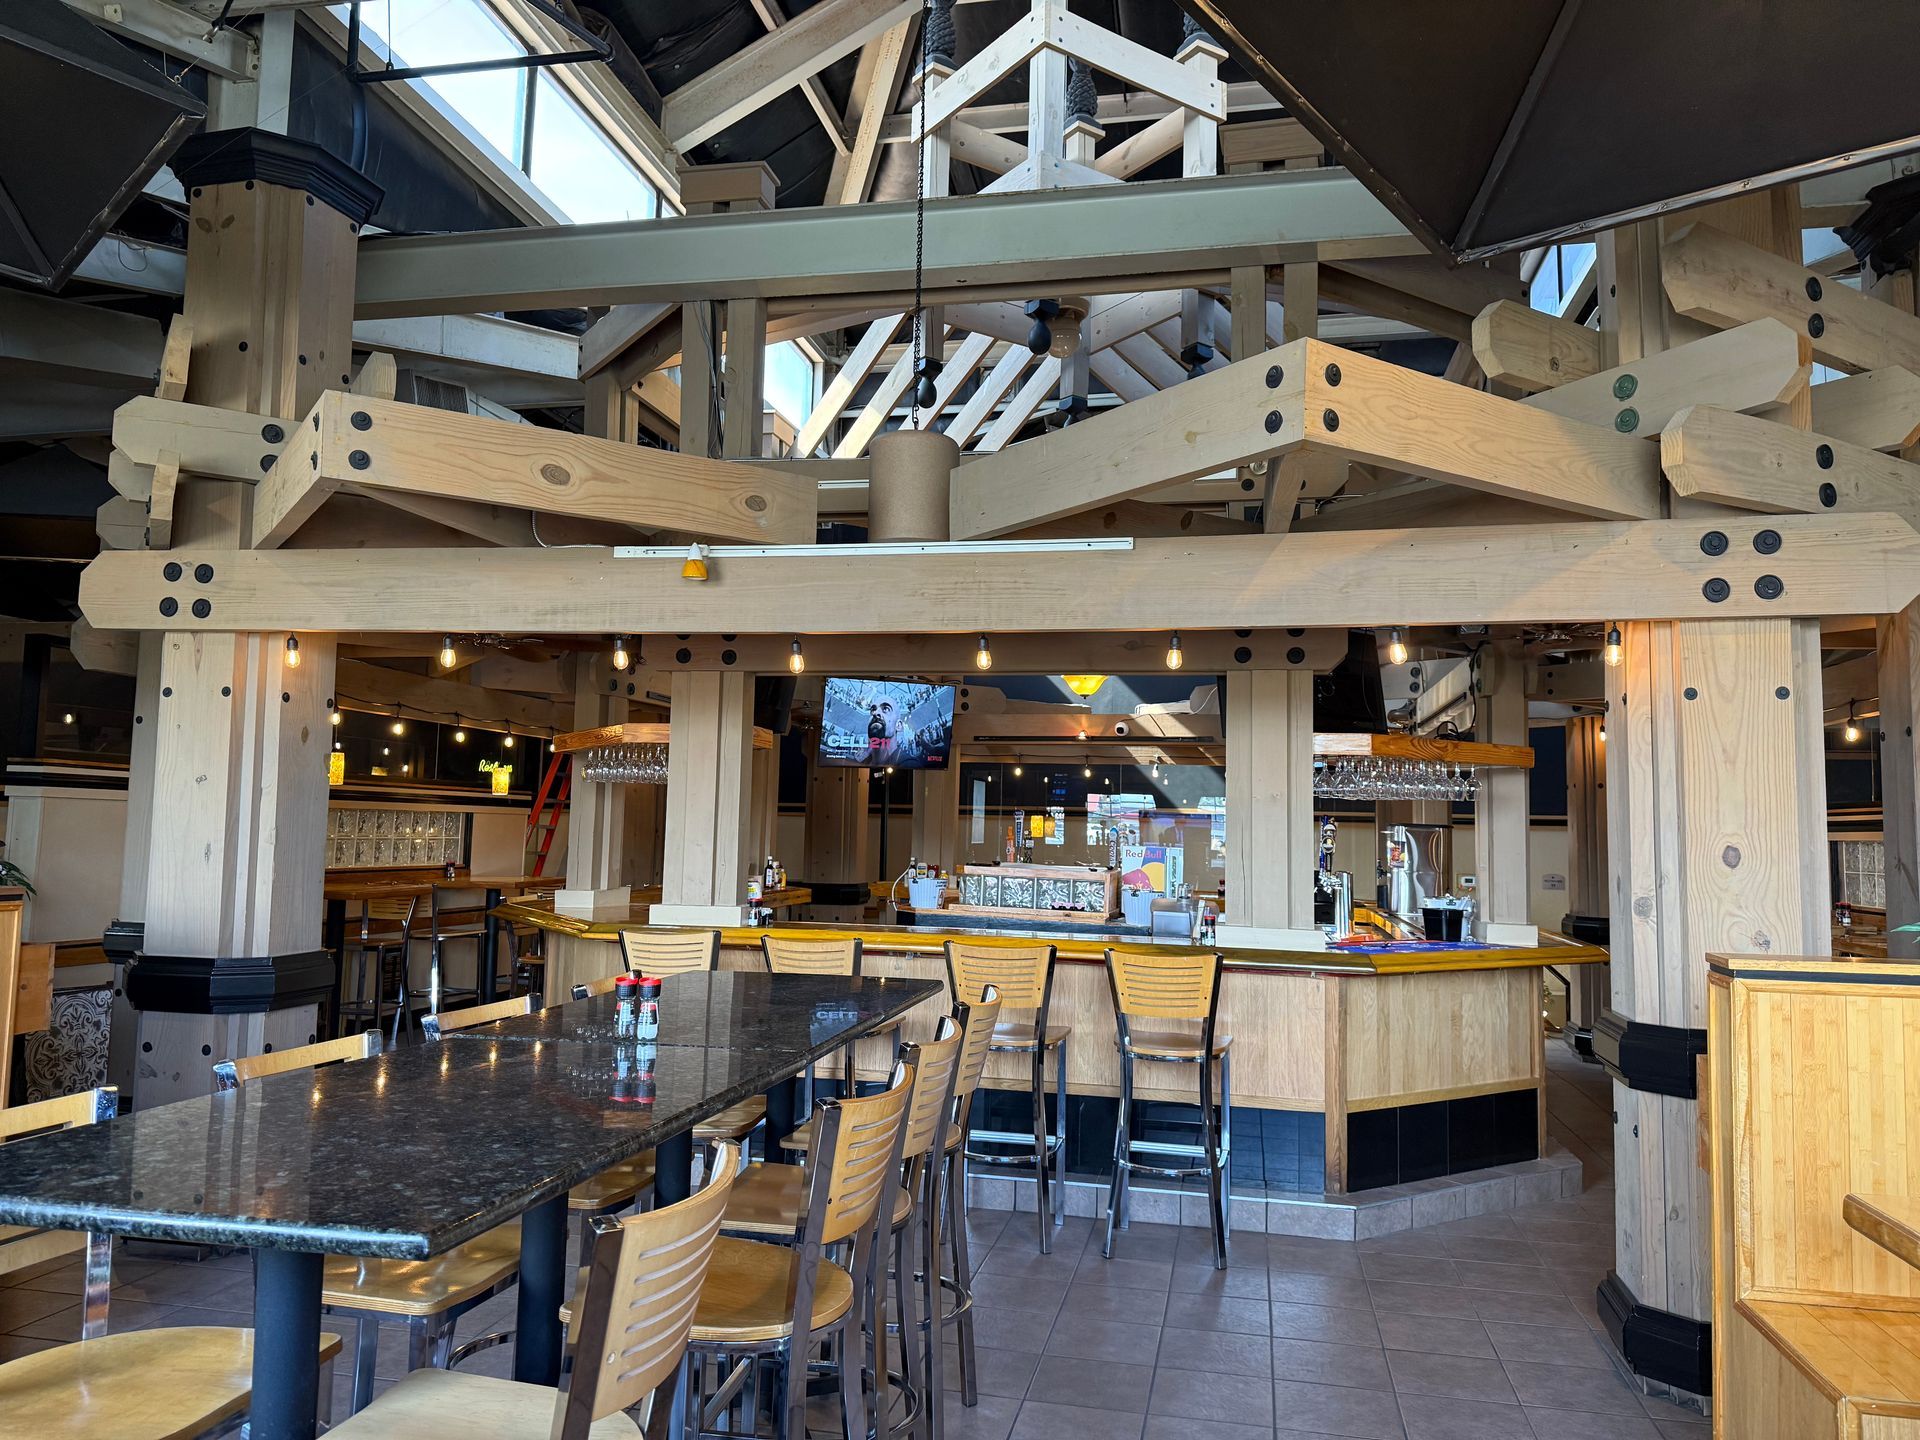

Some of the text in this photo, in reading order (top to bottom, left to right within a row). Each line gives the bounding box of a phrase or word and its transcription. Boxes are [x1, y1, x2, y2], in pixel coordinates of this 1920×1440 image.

[827, 734, 891, 749] CELL 211
[1125, 849, 1162, 859] Red Bull
